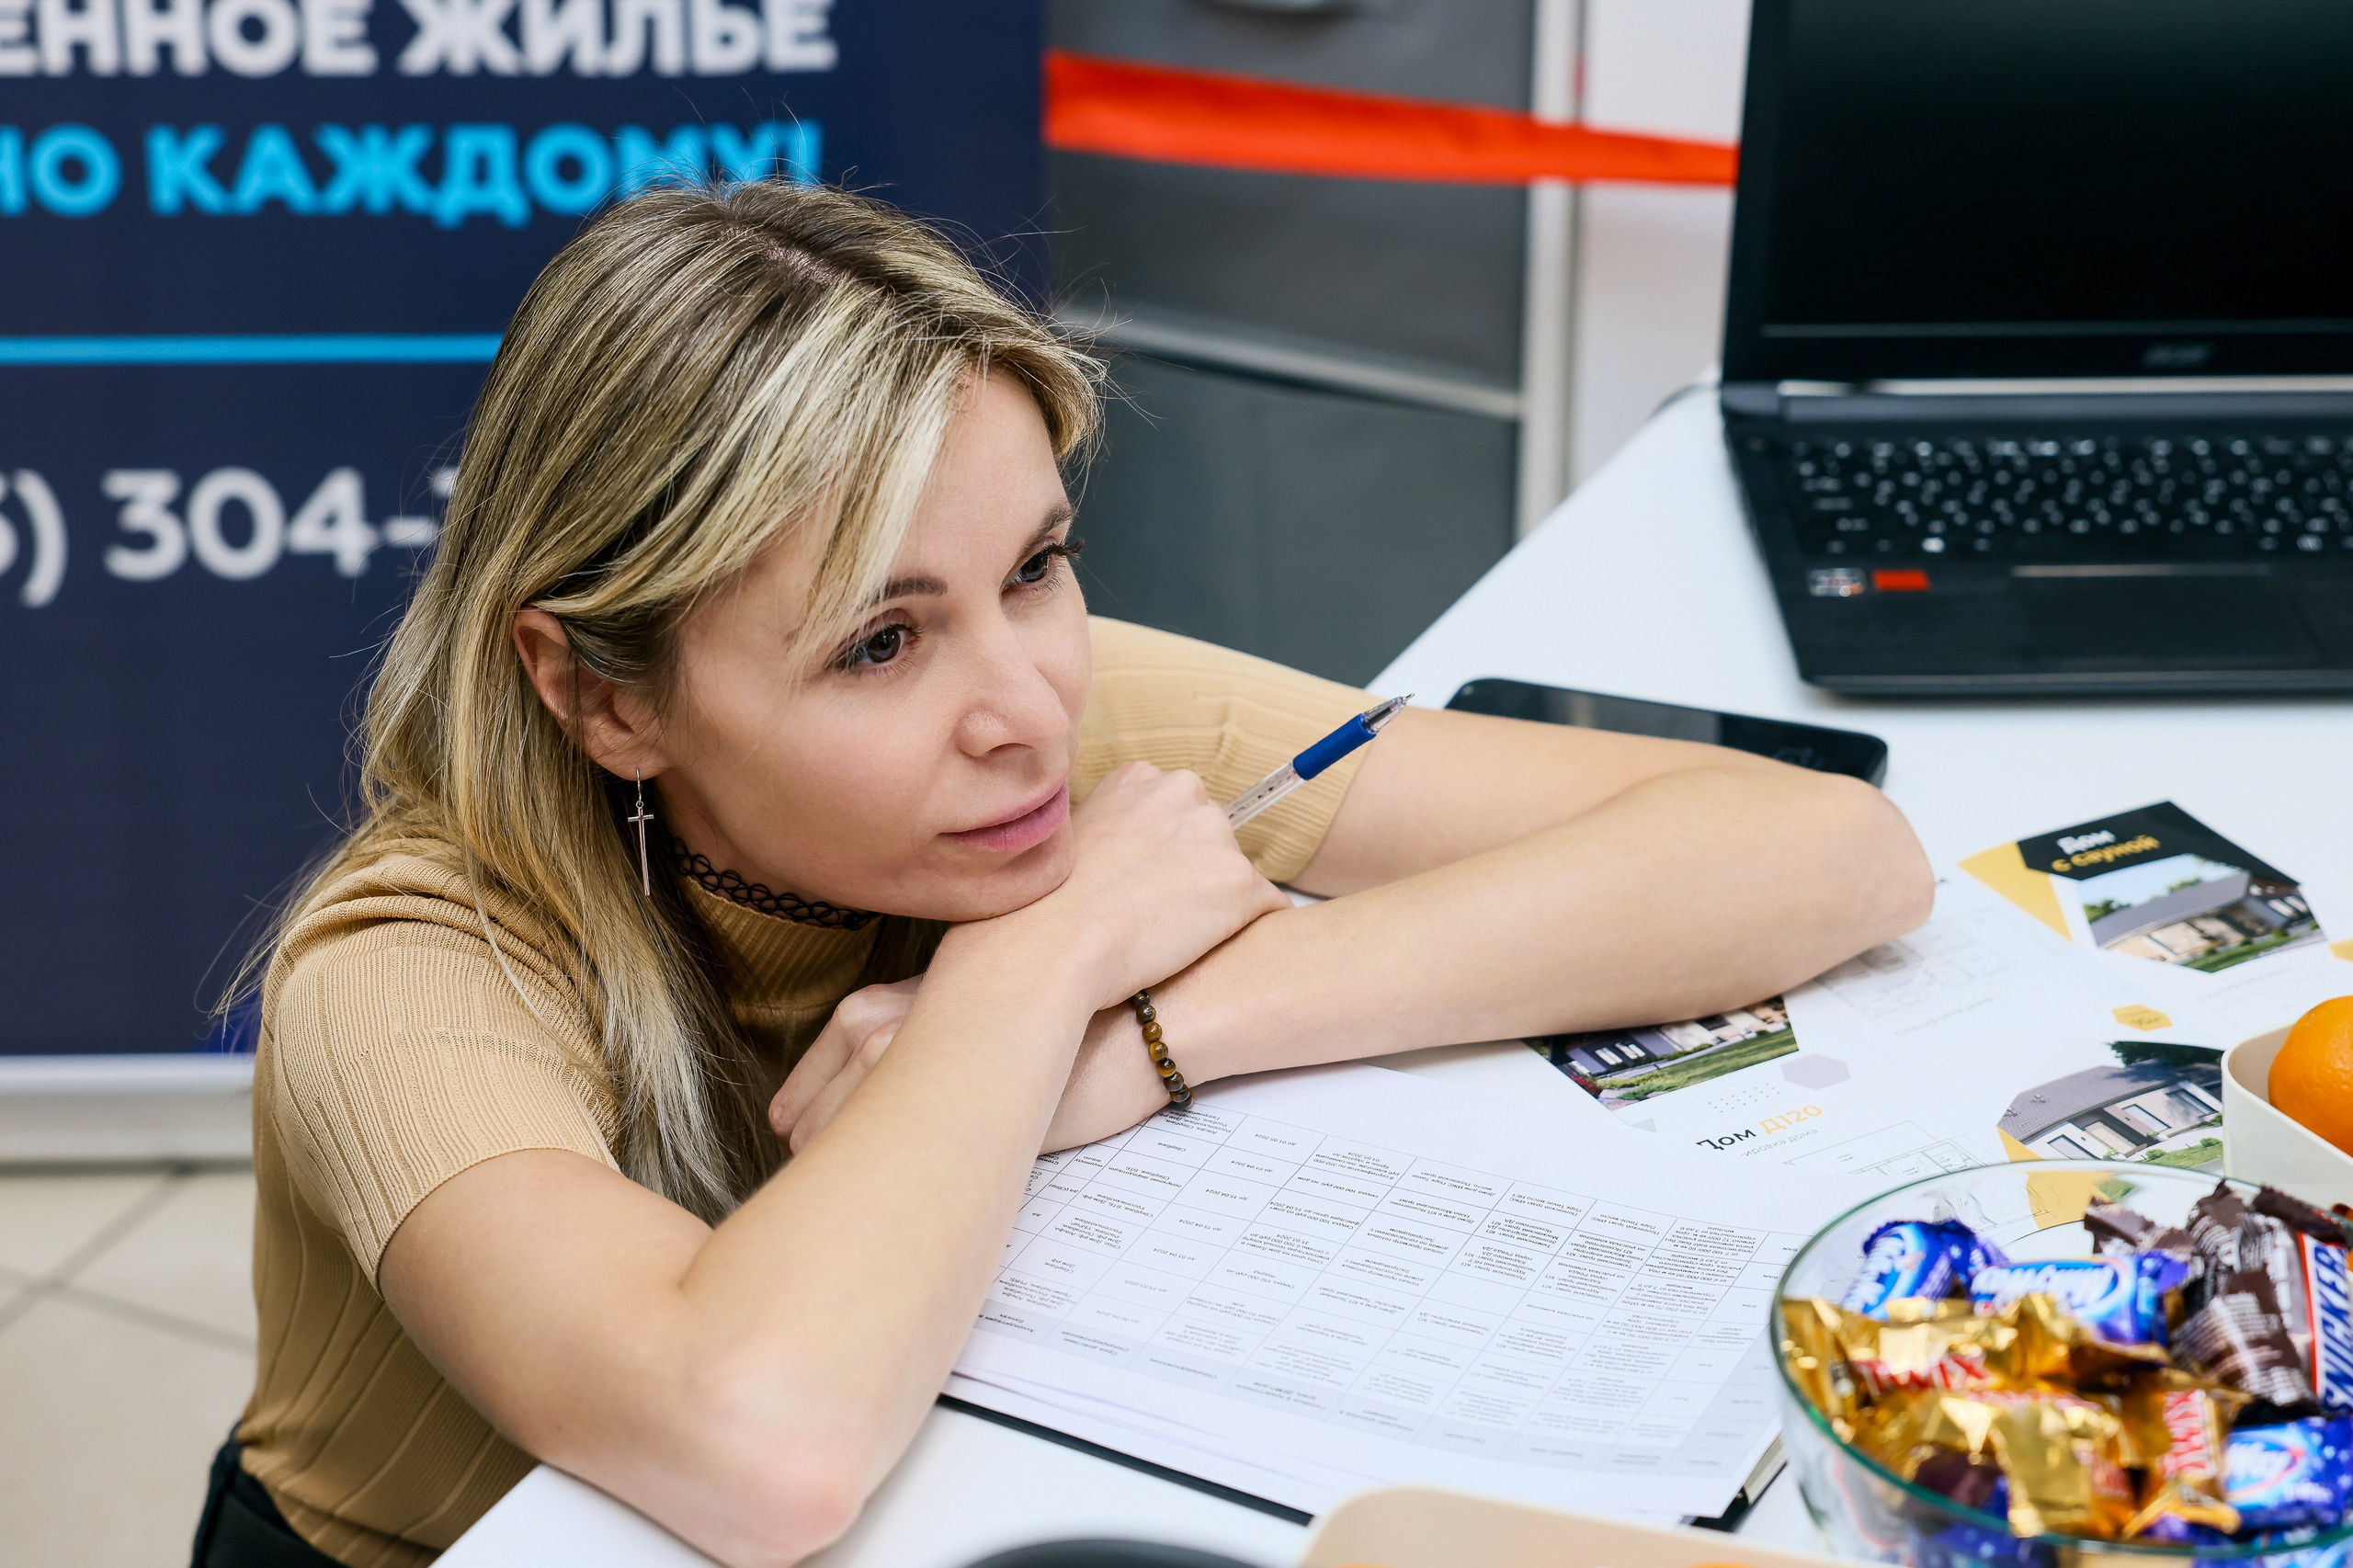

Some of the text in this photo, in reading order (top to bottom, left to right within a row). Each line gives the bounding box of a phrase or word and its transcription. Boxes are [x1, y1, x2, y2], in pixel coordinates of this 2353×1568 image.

[397, 0, 840, 77] ЖИЛЬЕ
[143, 119, 825, 228] КАЖДОМУ!
[99, 464, 460, 583] 304-
[1758, 1105, 1823, 1134] Д120
[1155, 1142, 1187, 1152] Сбербанк
[1789, 1128, 1818, 1142] дома
[1204, 1188, 1238, 1199] 15.04.2024
